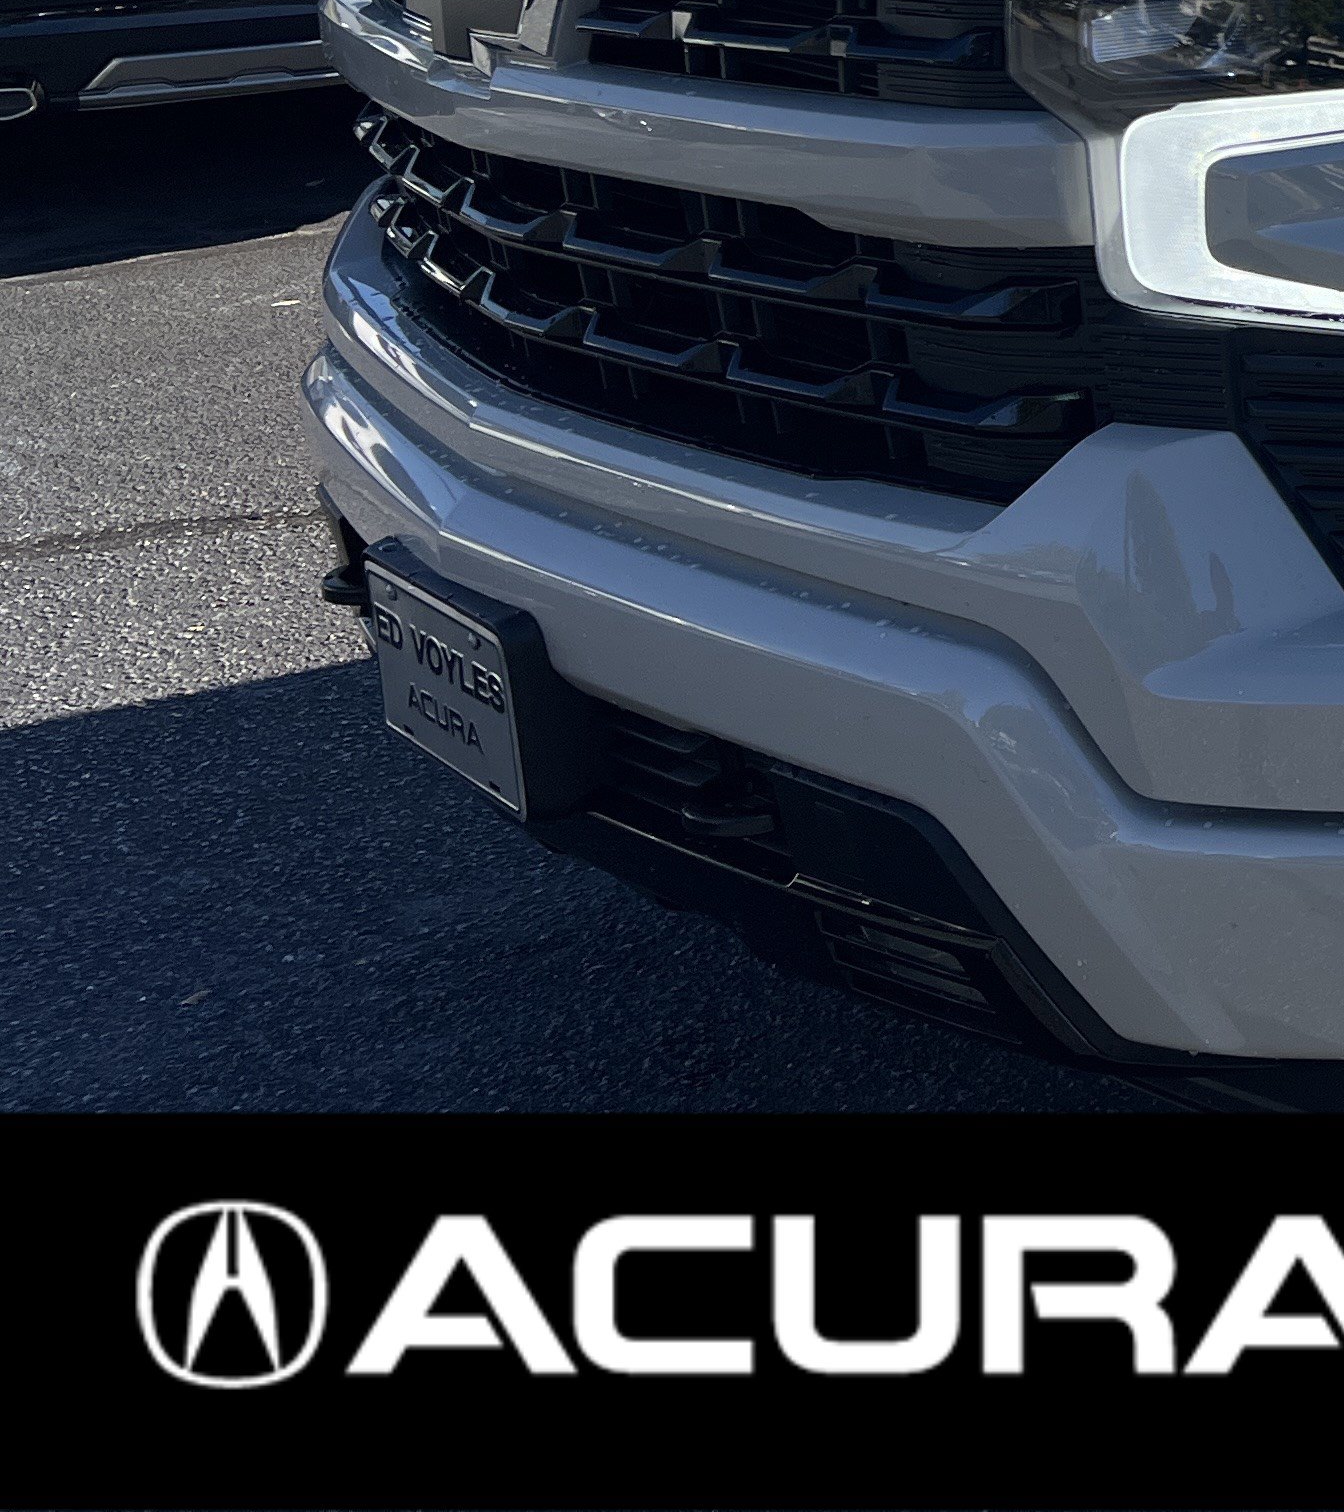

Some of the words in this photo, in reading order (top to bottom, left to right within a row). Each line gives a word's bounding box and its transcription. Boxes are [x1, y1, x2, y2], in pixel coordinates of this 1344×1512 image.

[374, 601, 403, 650] ED
[408, 623, 505, 714] VOYLES
[407, 682, 485, 756] ACURA
